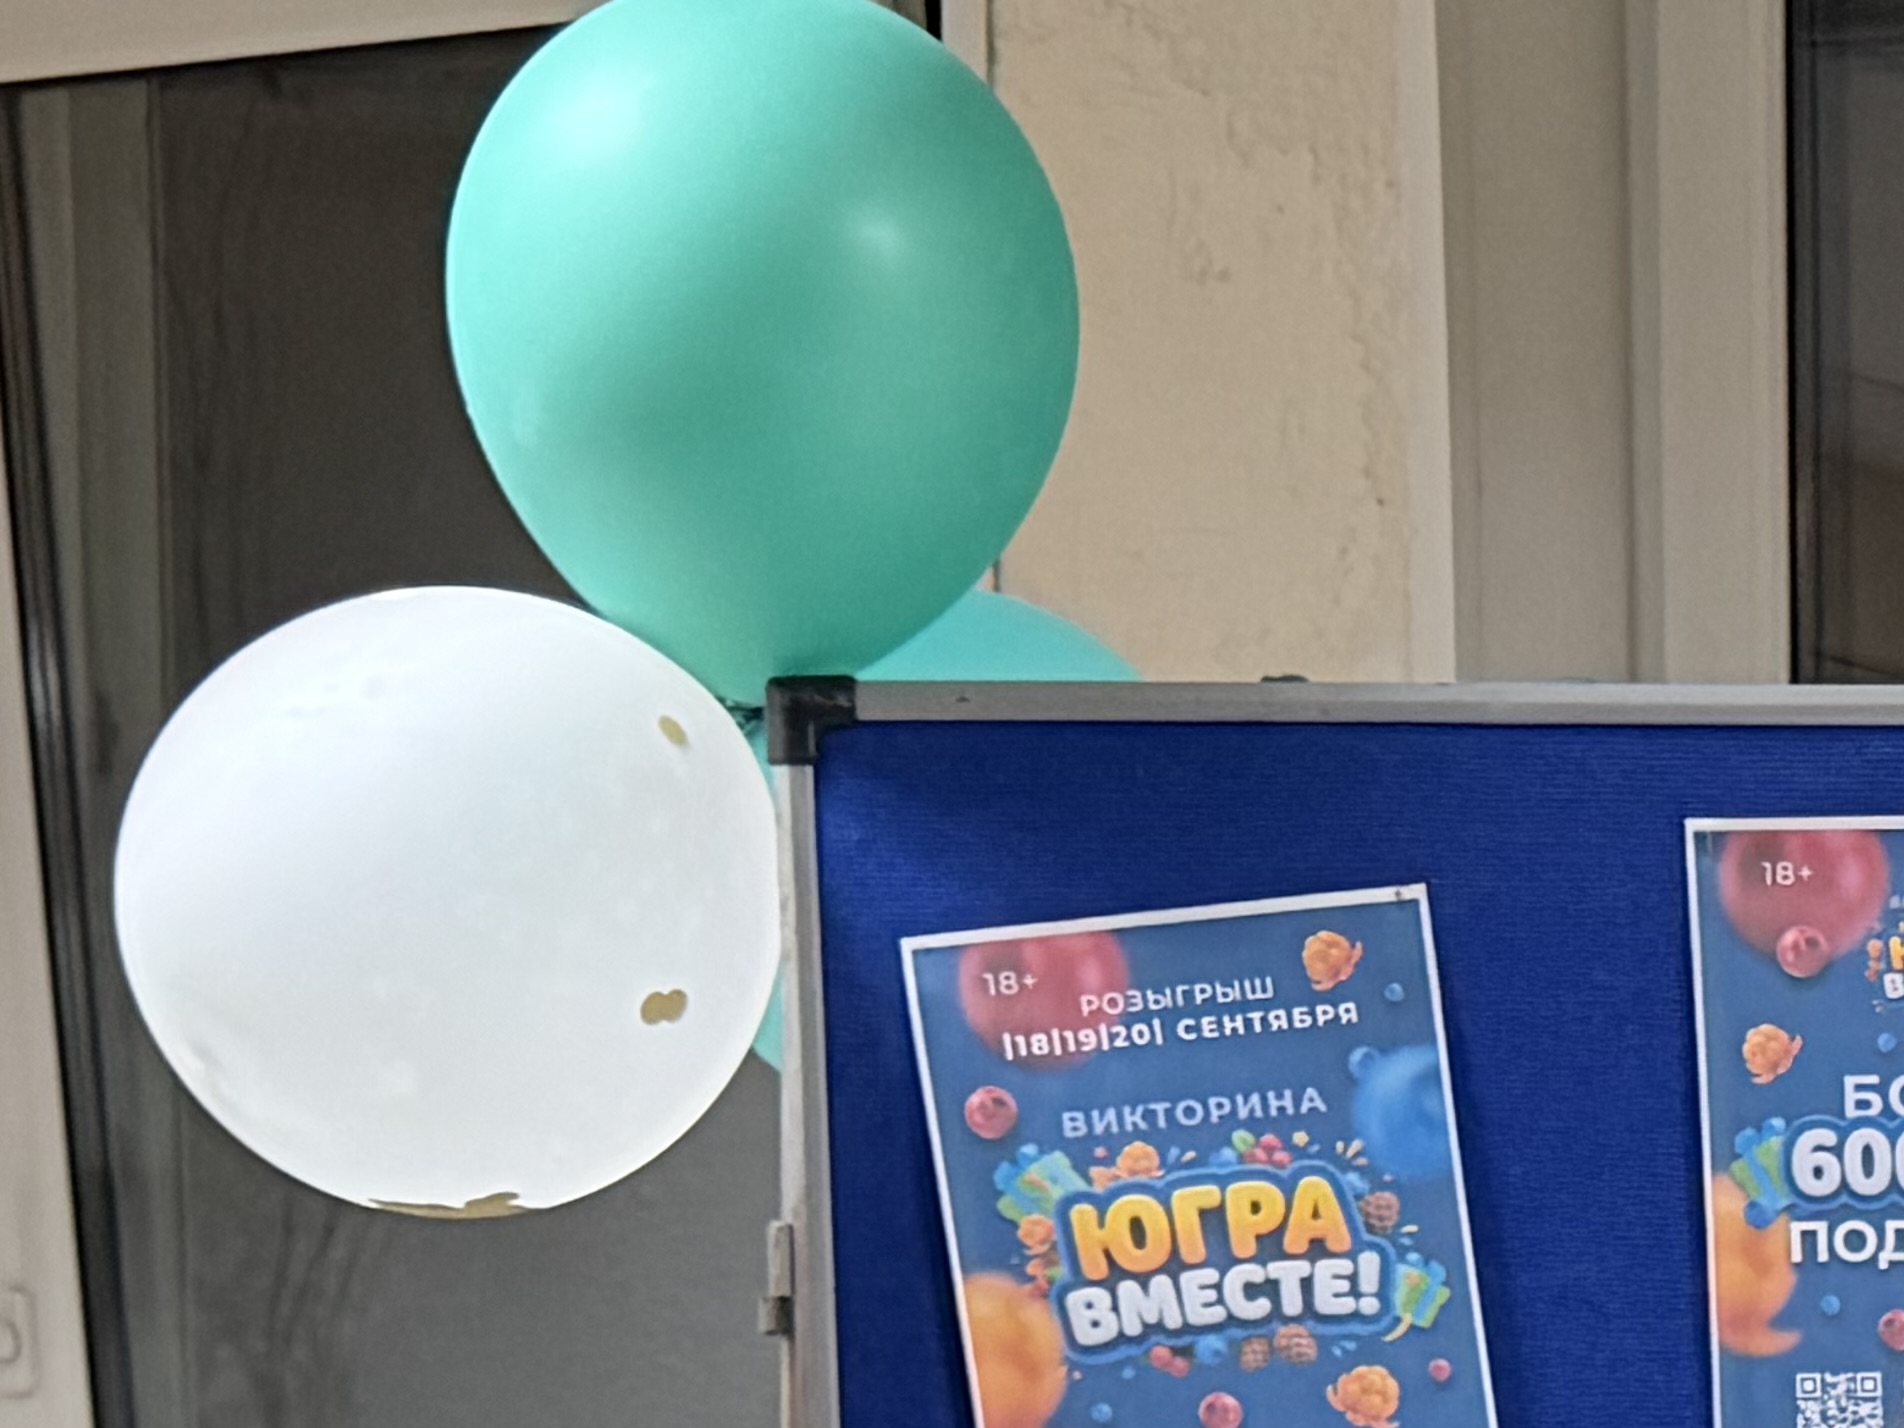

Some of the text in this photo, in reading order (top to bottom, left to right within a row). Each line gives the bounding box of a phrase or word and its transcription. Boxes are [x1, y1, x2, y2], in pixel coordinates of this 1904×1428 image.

[1761, 861, 1814, 886] 18+
[981, 970, 1039, 998] 18+
[1079, 976, 1275, 1018] РОЗЫГРЫШ
[1175, 1001, 1361, 1044] СЕНТЯБРЯ
[1061, 1087, 1327, 1139] ВИКТОРИНА
[1069, 1175, 1352, 1281] ЮГРА
[1064, 1250, 1383, 1348] ВМЕСТЕ!
